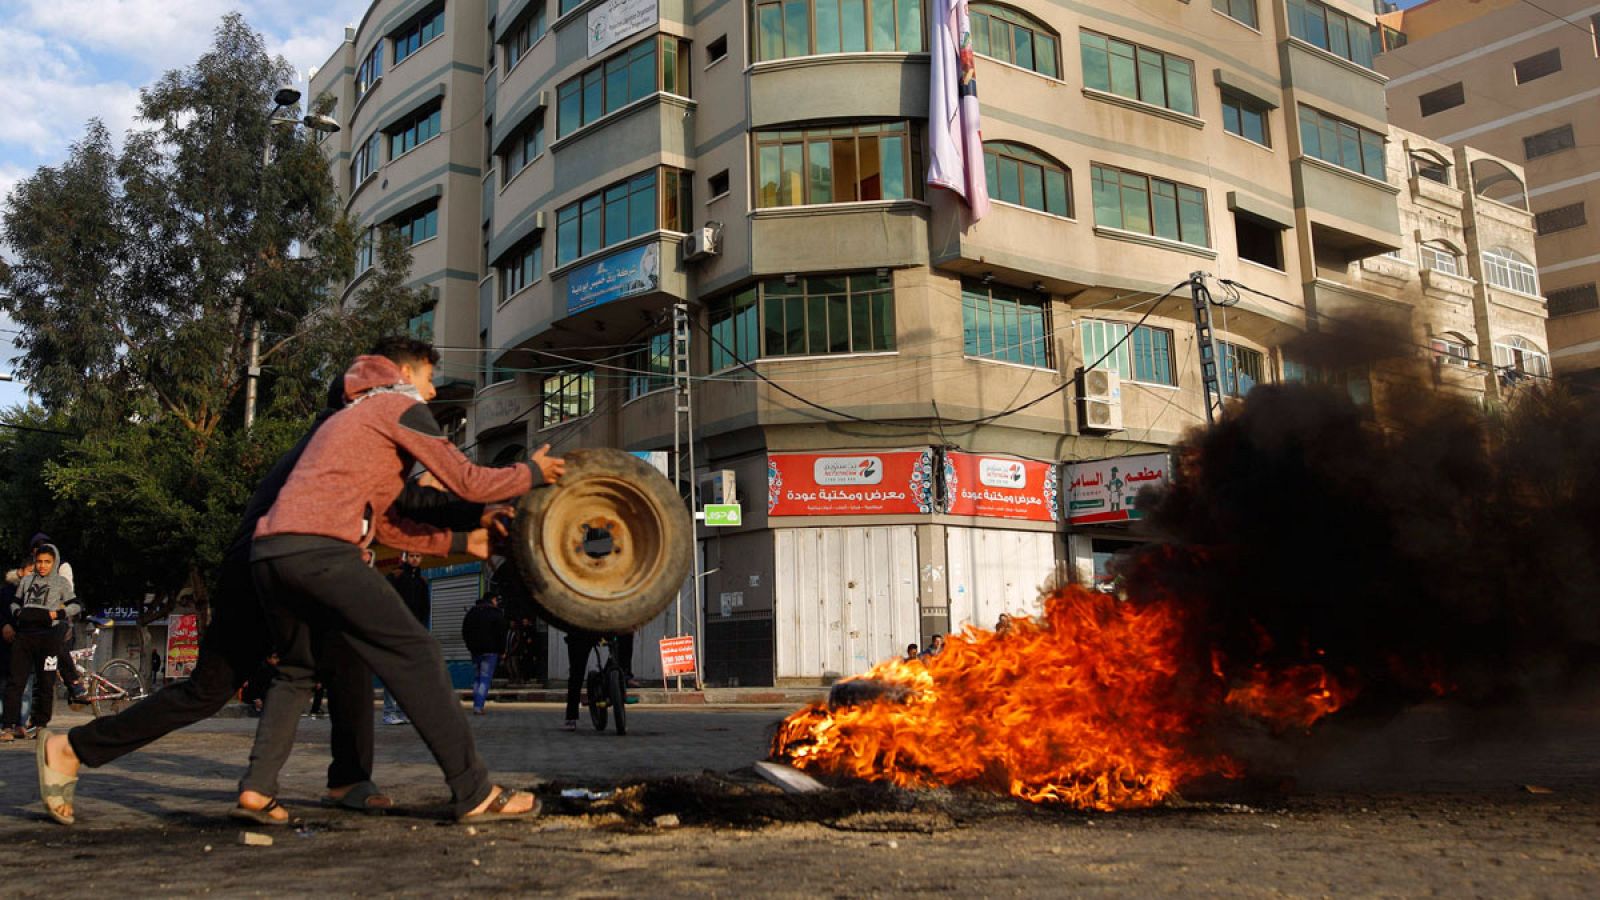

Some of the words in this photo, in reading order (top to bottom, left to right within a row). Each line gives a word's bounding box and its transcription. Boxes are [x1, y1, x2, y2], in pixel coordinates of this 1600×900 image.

[1125, 467, 1163, 486] مطعم
[787, 489, 817, 502] عودة
[818, 488, 862, 502] ومكتبة
[864, 489, 906, 501] معرض
[1014, 493, 1042, 505] معرض
